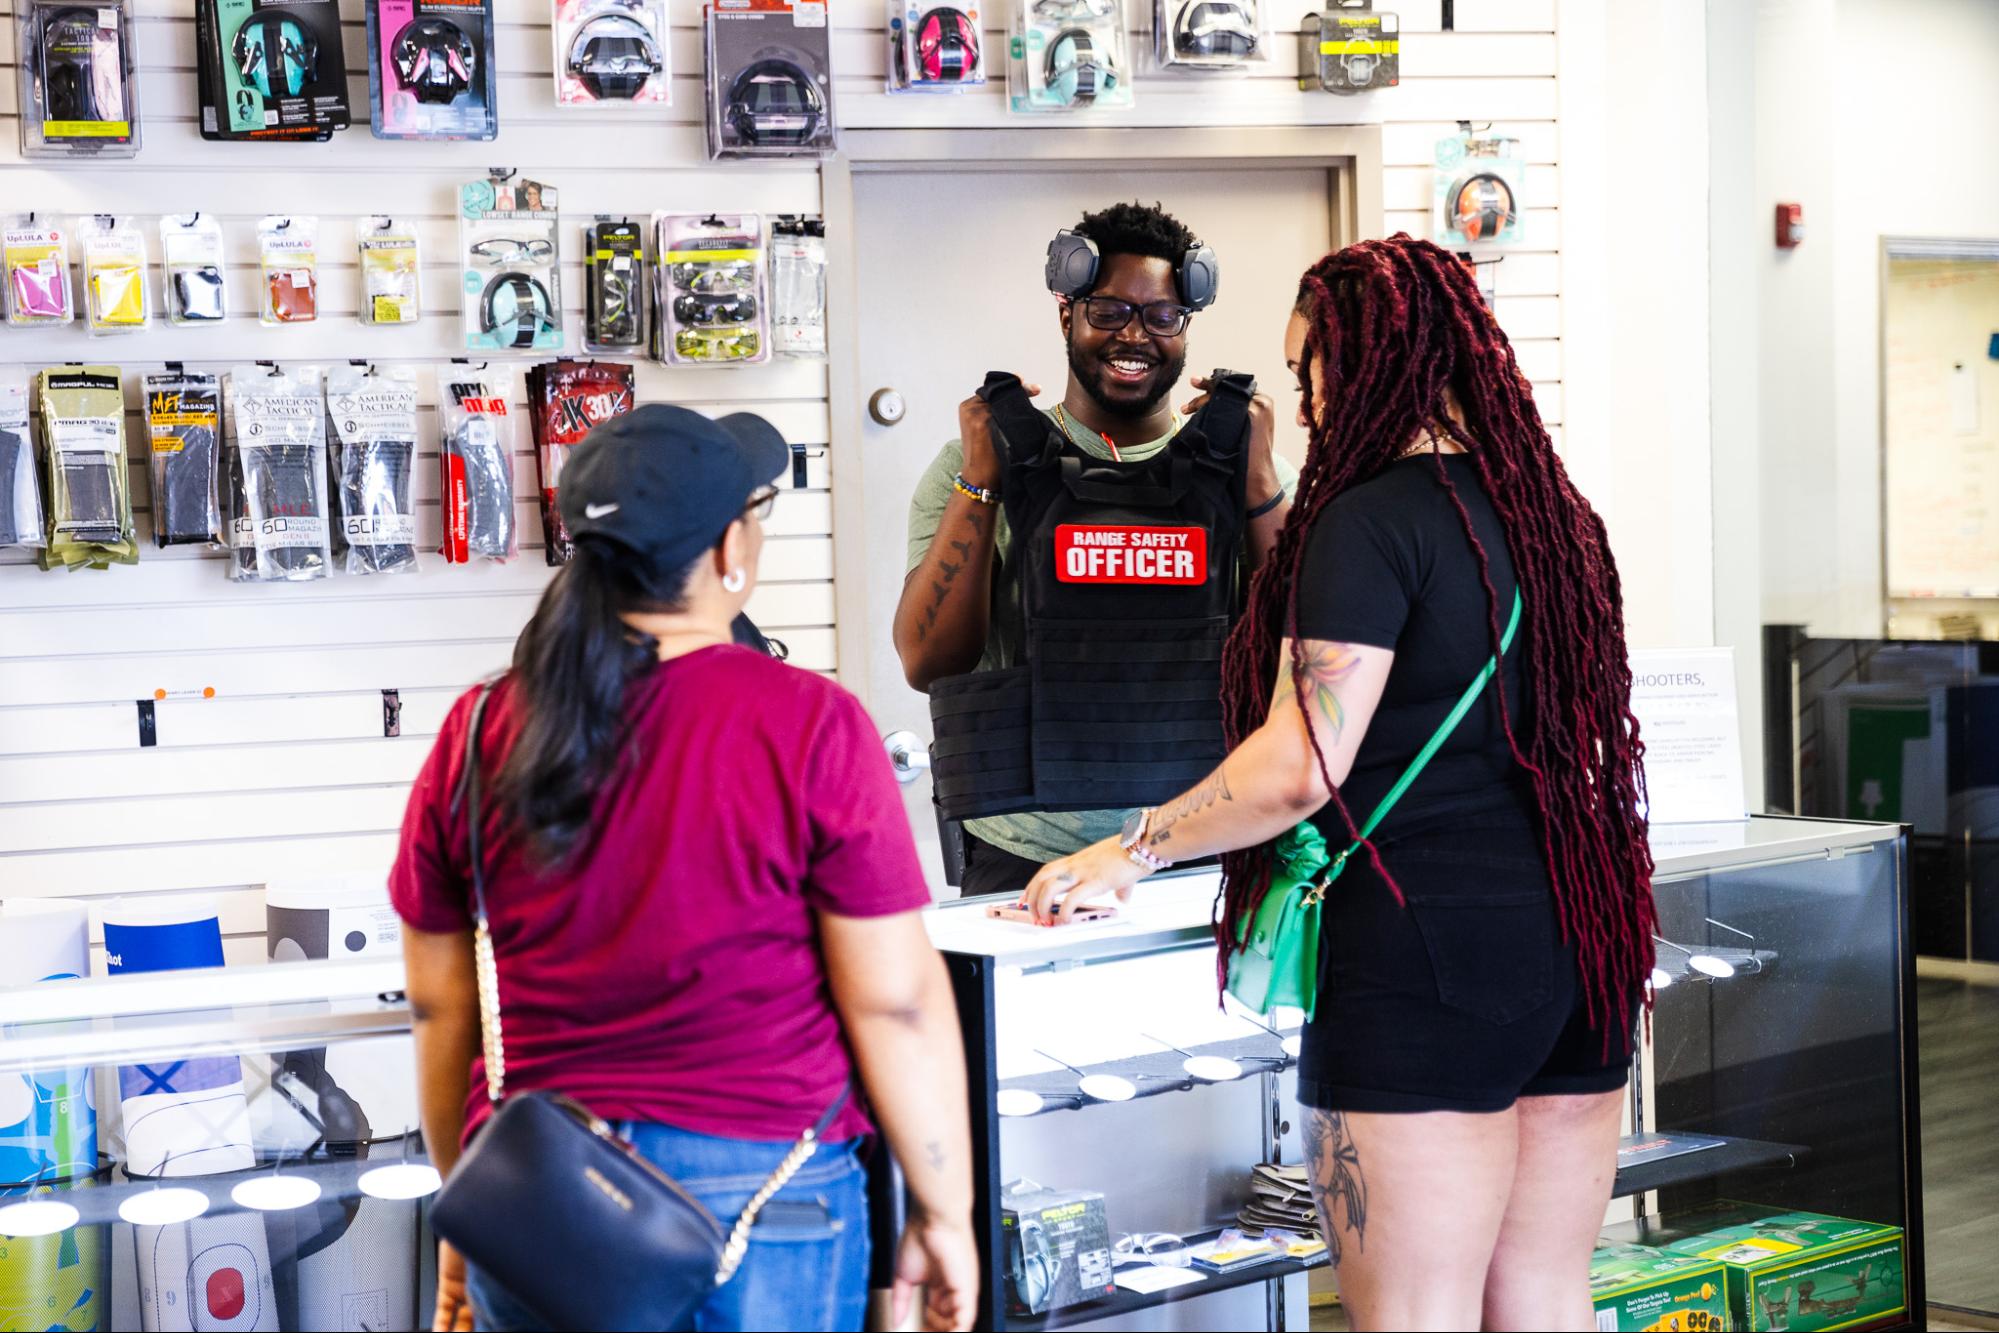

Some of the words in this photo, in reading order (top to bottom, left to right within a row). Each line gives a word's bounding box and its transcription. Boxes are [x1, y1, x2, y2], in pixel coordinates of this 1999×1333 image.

[7, 233, 43, 242] UpLULA
[269, 239, 303, 248] UpLULA
[265, 398, 318, 406] AMERICAN
[359, 393, 412, 403] AMERICAN
[266, 406, 312, 415] TACTICAL
[360, 402, 408, 412] TACTICAL
[262, 518, 288, 535] 60
[1073, 531, 1127, 546] RANGE
[1130, 532, 1188, 547] SAFETY
[1066, 547, 1195, 578] OFFICER
[60, 1101, 67, 1114] 8
[1041, 1202, 1086, 1222] PELTOR
